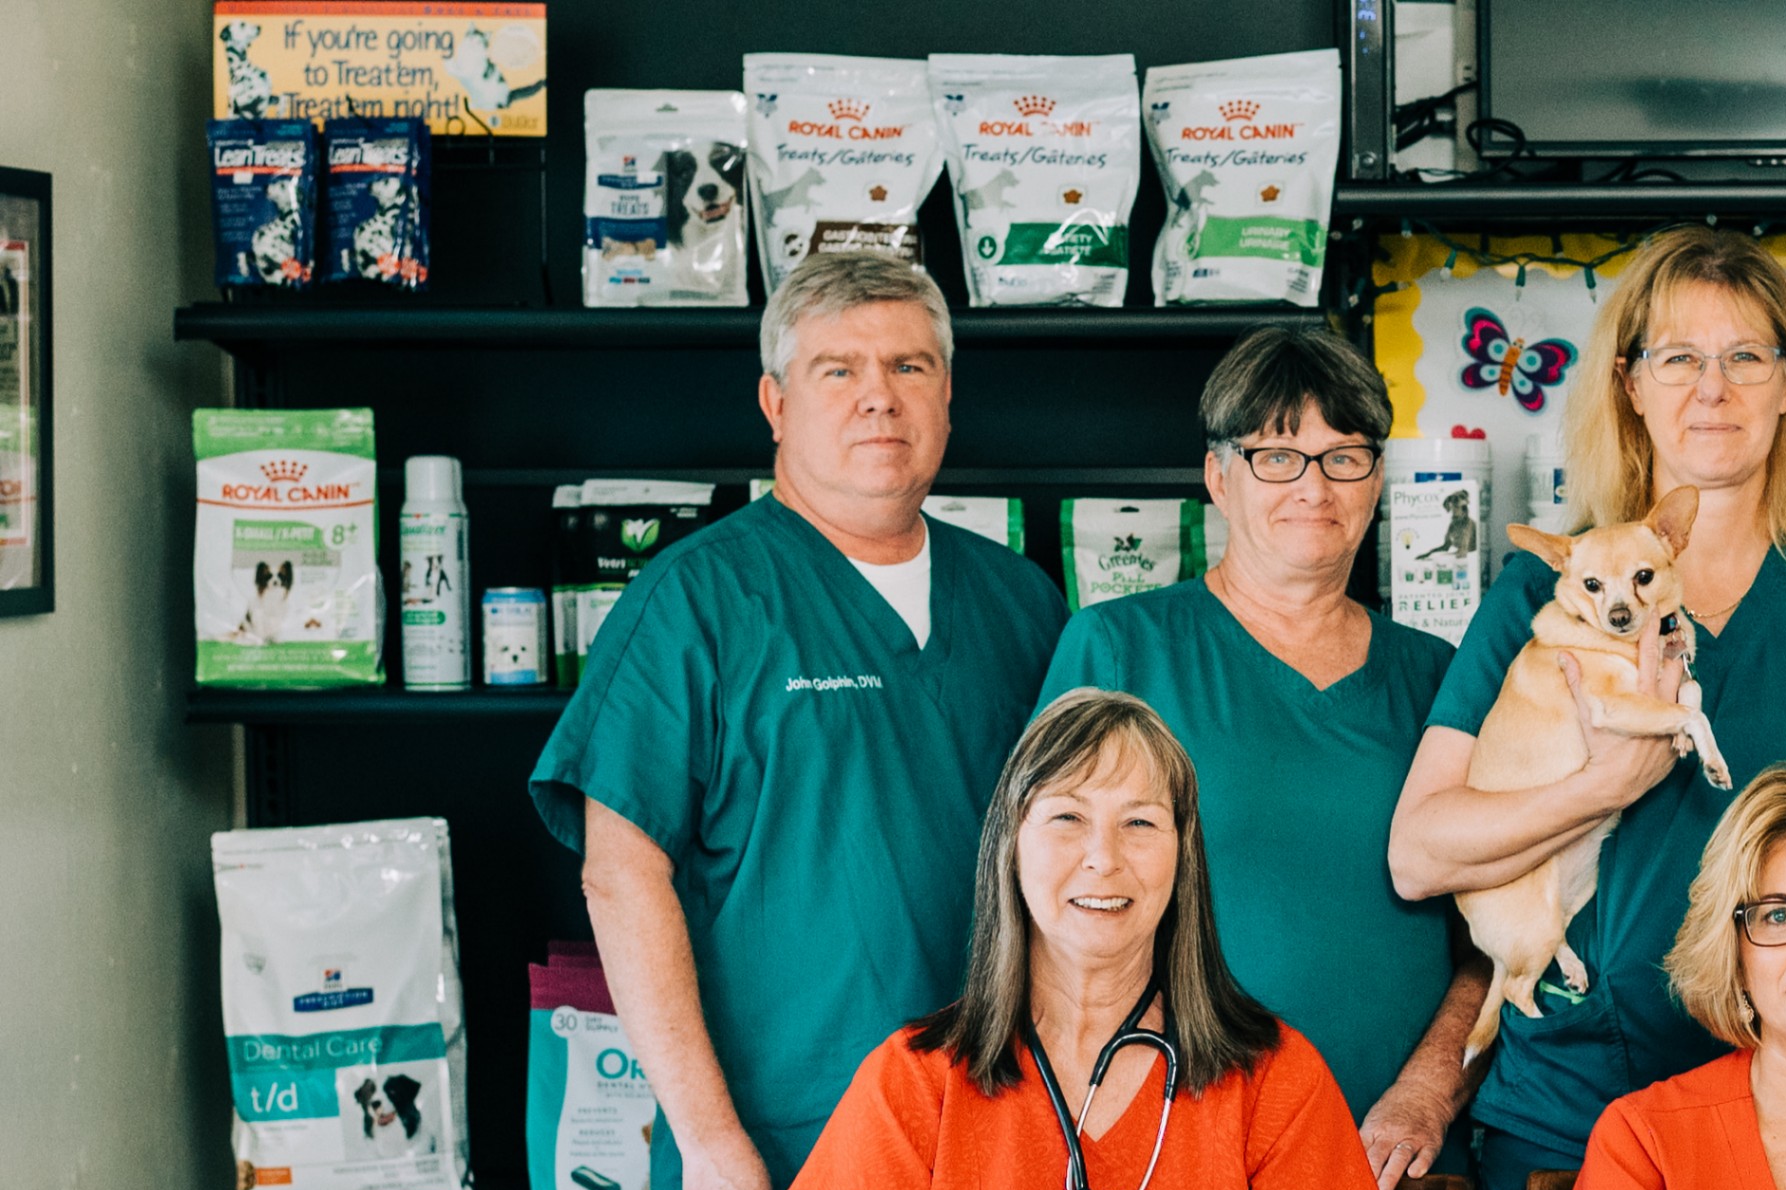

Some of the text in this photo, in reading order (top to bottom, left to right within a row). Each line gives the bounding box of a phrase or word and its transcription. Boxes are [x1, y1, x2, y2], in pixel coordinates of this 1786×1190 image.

[284, 20, 454, 59] If you're going
[304, 65, 328, 86] to
[788, 120, 903, 141] ROYAL CANIN
[979, 122, 1032, 136] ROYAL
[1181, 123, 1295, 141] ROYAL CANIN
[222, 484, 350, 502] ROYAL CANIN
[1098, 552, 1158, 571] Greenies
[1399, 598, 1471, 611] RELIEF
[786, 674, 883, 691] John Golphin, DVM
[554, 1014, 577, 1031] 30
[243, 1036, 382, 1062] Dental Care
[250, 1082, 298, 1113] t/d
